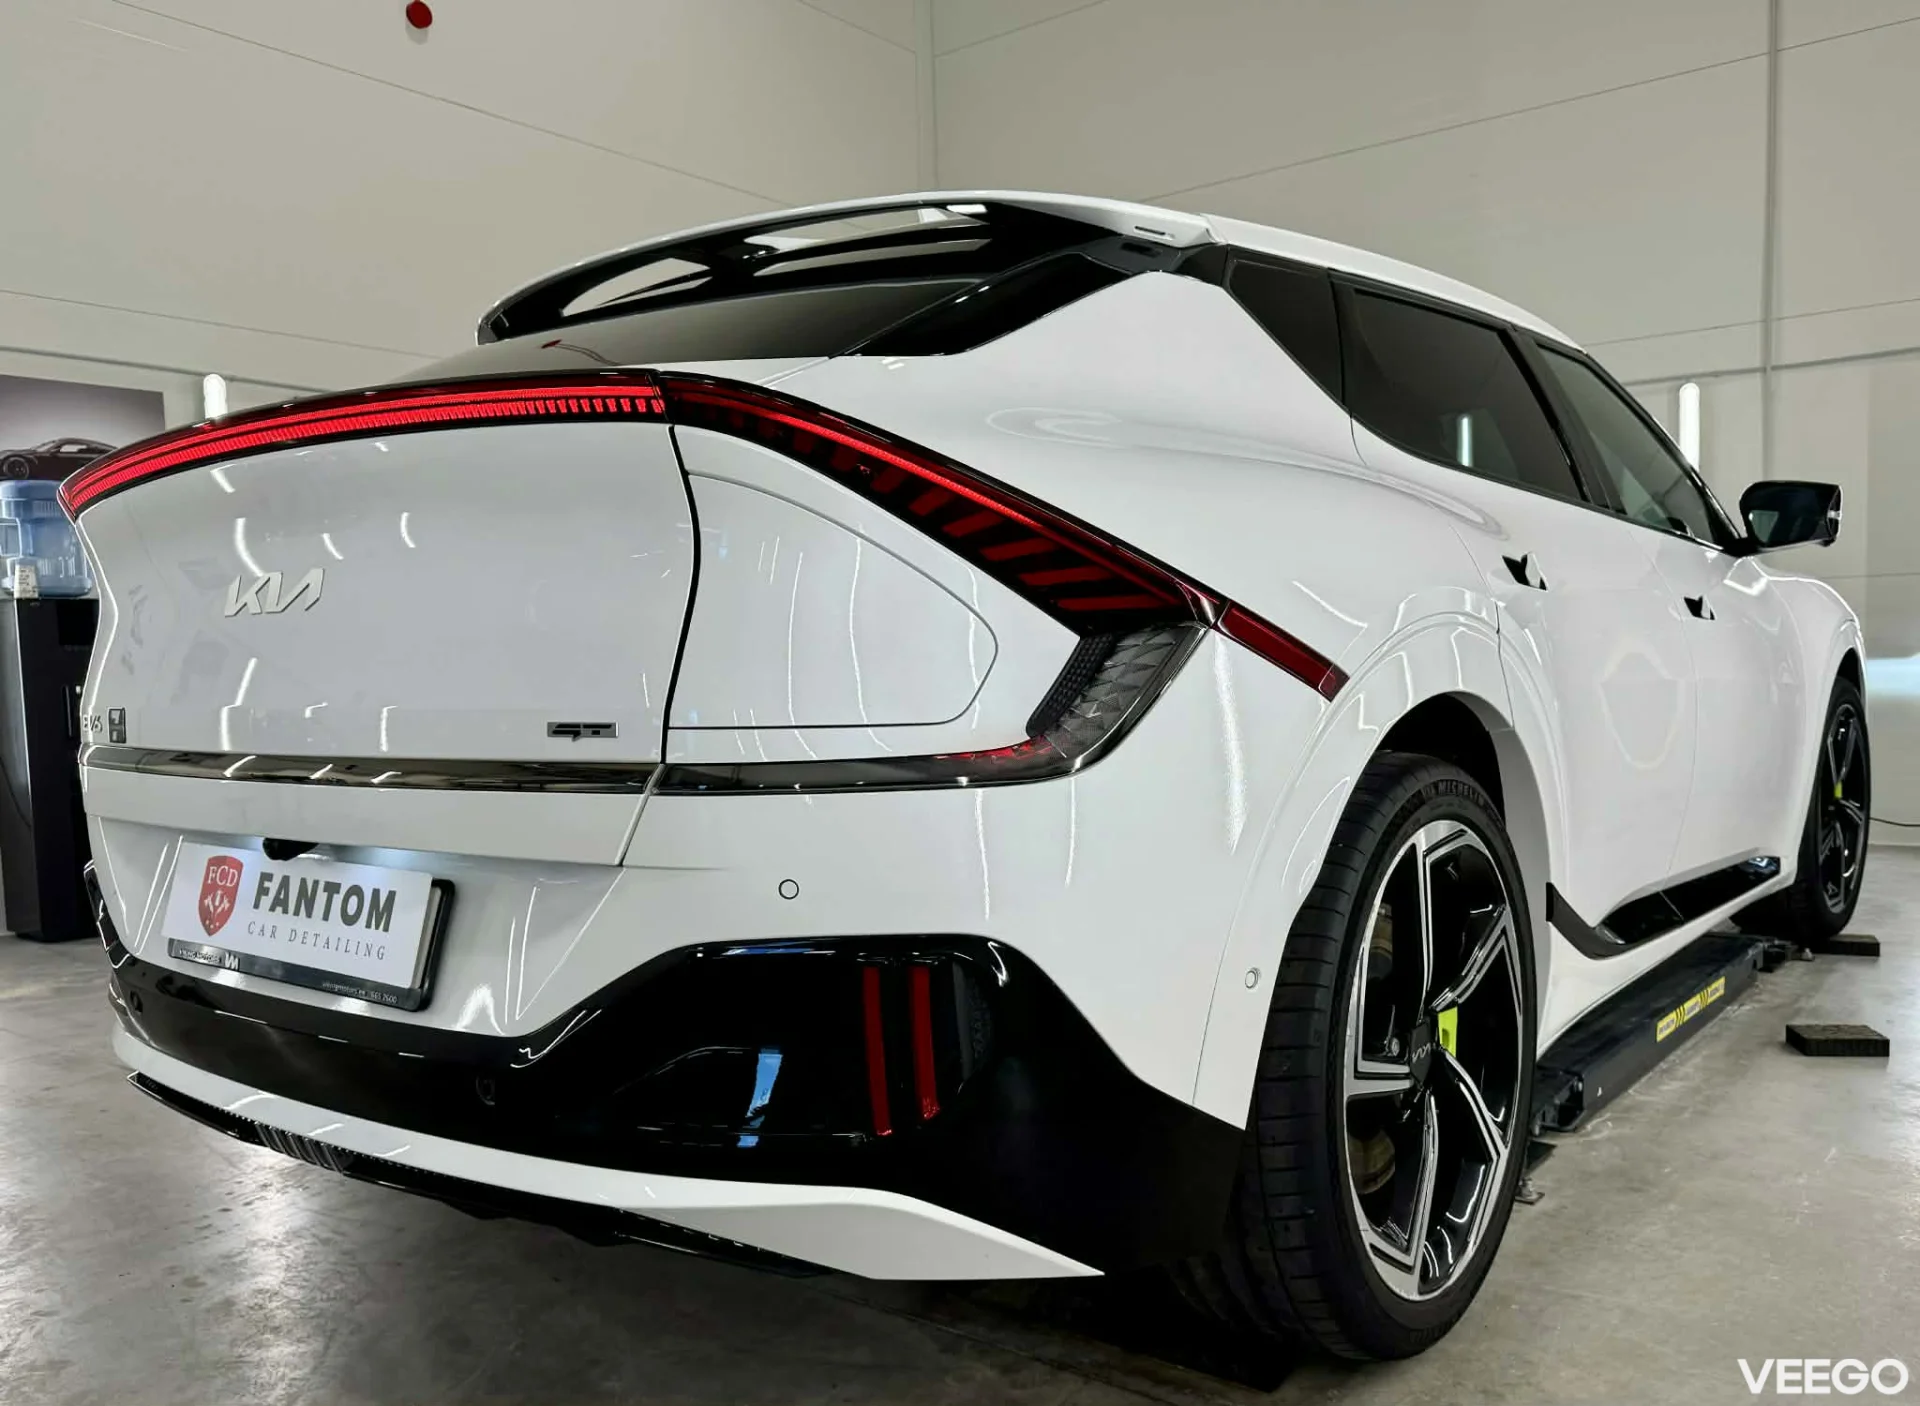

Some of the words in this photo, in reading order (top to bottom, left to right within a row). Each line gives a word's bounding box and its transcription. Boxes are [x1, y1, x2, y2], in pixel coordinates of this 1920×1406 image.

[207, 865, 239, 887] FCD
[252, 871, 397, 932] FANTOM
[247, 921, 278, 940] CAR
[288, 929, 386, 960] DETAILING
